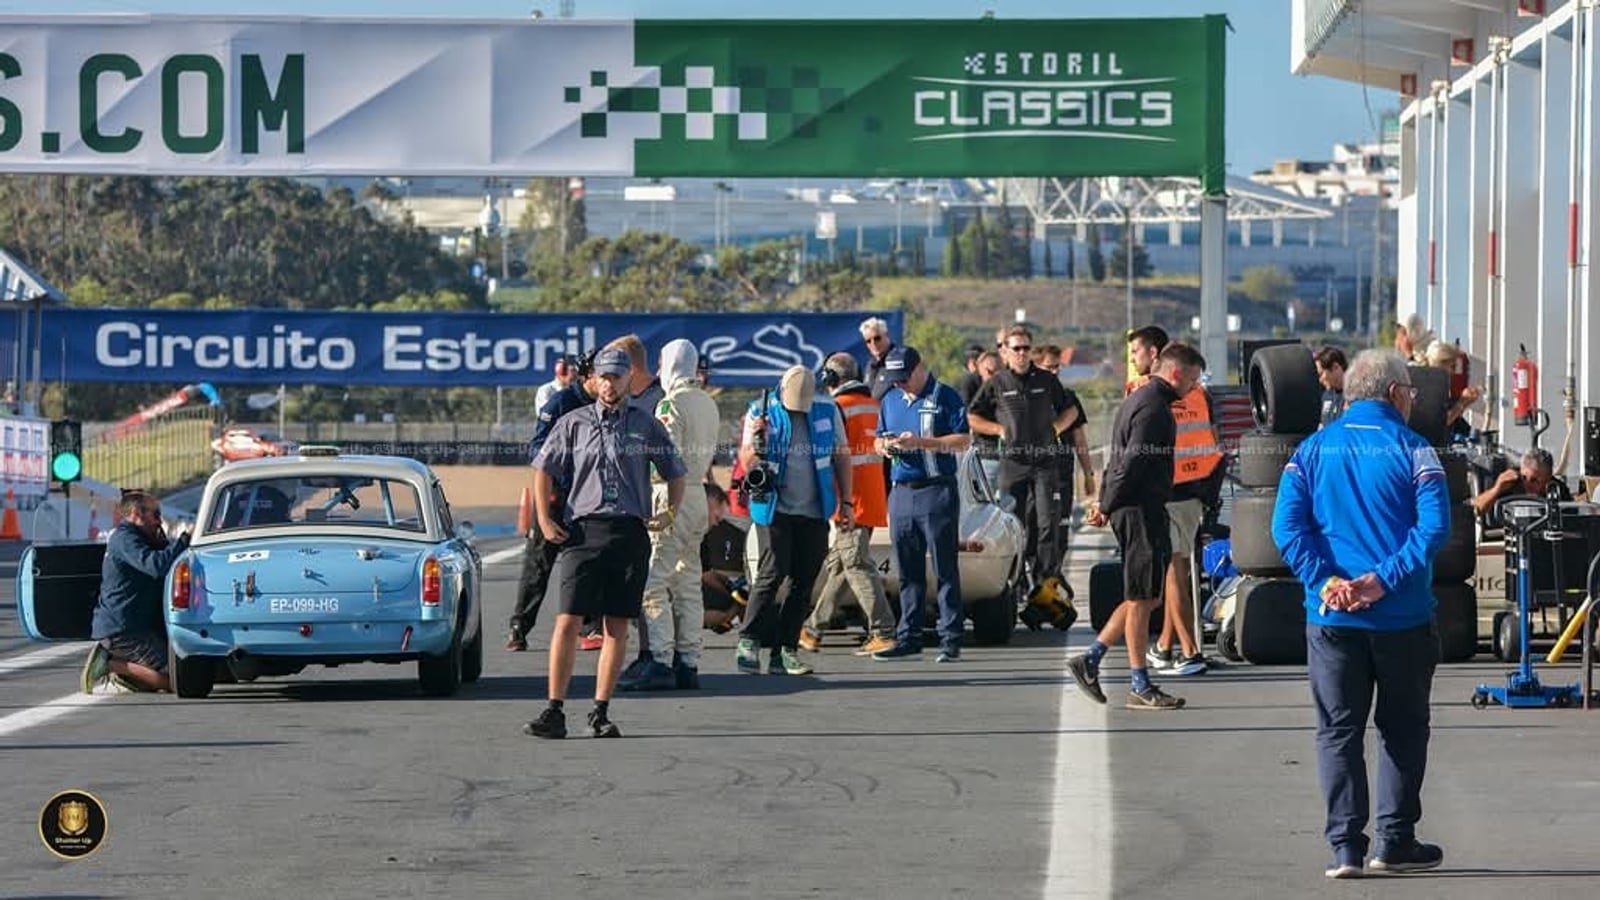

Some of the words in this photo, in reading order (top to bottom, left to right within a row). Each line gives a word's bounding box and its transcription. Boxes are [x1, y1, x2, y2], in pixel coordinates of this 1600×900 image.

[964, 52, 1123, 75] ESTORIL
[914, 90, 1173, 126] CLASSICS
[95, 321, 356, 370] Circuito
[383, 325, 597, 371] Estoril
[270, 598, 339, 613] EP-099-HG
